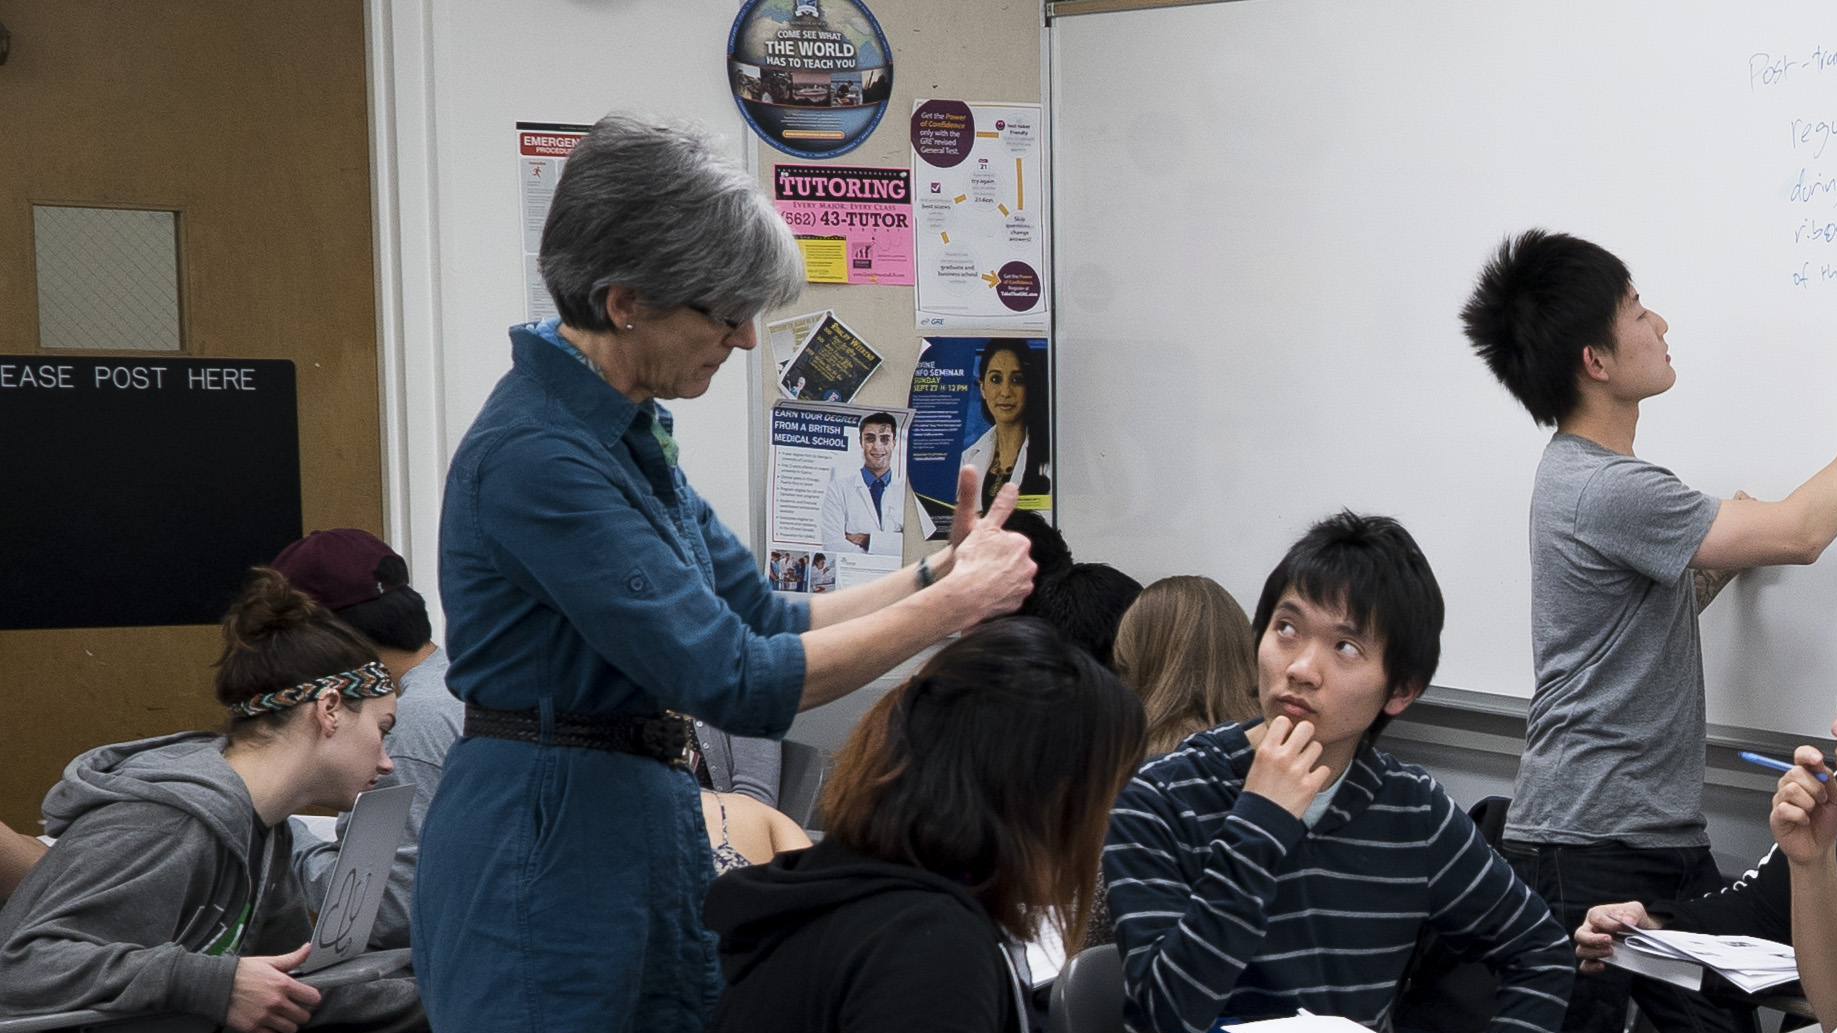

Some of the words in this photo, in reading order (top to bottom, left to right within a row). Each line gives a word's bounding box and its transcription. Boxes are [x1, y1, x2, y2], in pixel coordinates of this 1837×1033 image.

[777, 30, 801, 39] COME
[802, 30, 818, 39] SEE
[818, 31, 842, 41] WHAT
[766, 41, 795, 56] THE
[798, 41, 855, 57] WORLD
[766, 56, 786, 67] HAS
[788, 58, 801, 67] TO
[803, 58, 834, 69] TEACH
[836, 59, 856, 68] YOU
[920, 111, 933, 119] Get
[524, 135, 581, 148] EMERGEN
[779, 176, 906, 199] TUTORING
[793, 201, 816, 209] EVERY
[781, 211, 816, 227] (562)
[820, 211, 909, 228] 43-TUTOR
[1793, 261, 1809, 289] of
[0, 365, 75, 389] EASE
[94, 366, 168, 389] POST
[188, 368, 257, 390] HERE
[929, 368, 965, 377] SEMINAR
[775, 408, 798, 419] EARN
[800, 411, 823, 421] YOUR
[824, 414, 859, 424] DEGREE
[774, 421, 799, 431] FROM
[799, 423, 807, 432] A
[808, 424, 841, 435] BRITISH
[774, 433, 811, 444] MEDICAL
[812, 436, 847, 448] SCHOOL
